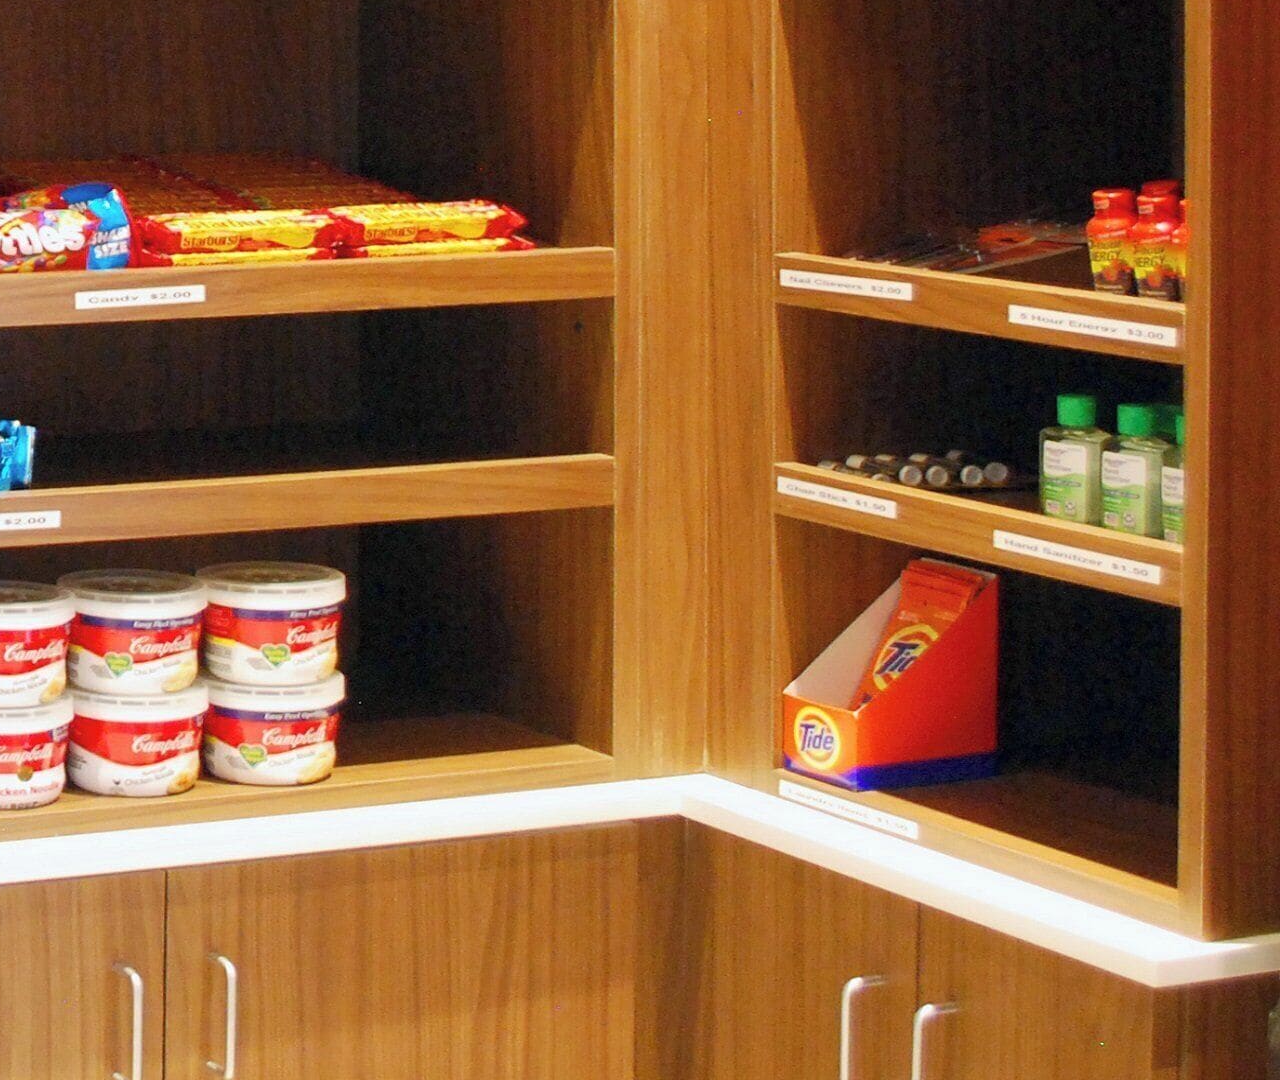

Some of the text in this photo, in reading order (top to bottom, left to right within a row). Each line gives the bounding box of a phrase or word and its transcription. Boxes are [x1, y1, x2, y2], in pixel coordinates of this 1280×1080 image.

[182, 234, 239, 248] Starburst
[94, 242, 129, 258] SIZE
[88, 290, 192, 306] Candy $2.00
[870, 284, 903, 296] $2.00
[1030, 313, 1065, 326] Hour
[1126, 326, 1165, 342] $3.00
[853, 497, 888, 513] $1.50
[3, 515, 48, 527] $2.00
[1003, 537, 1150, 577] Hand Sanitizer $1.50
[799, 722, 835, 752] Tide
